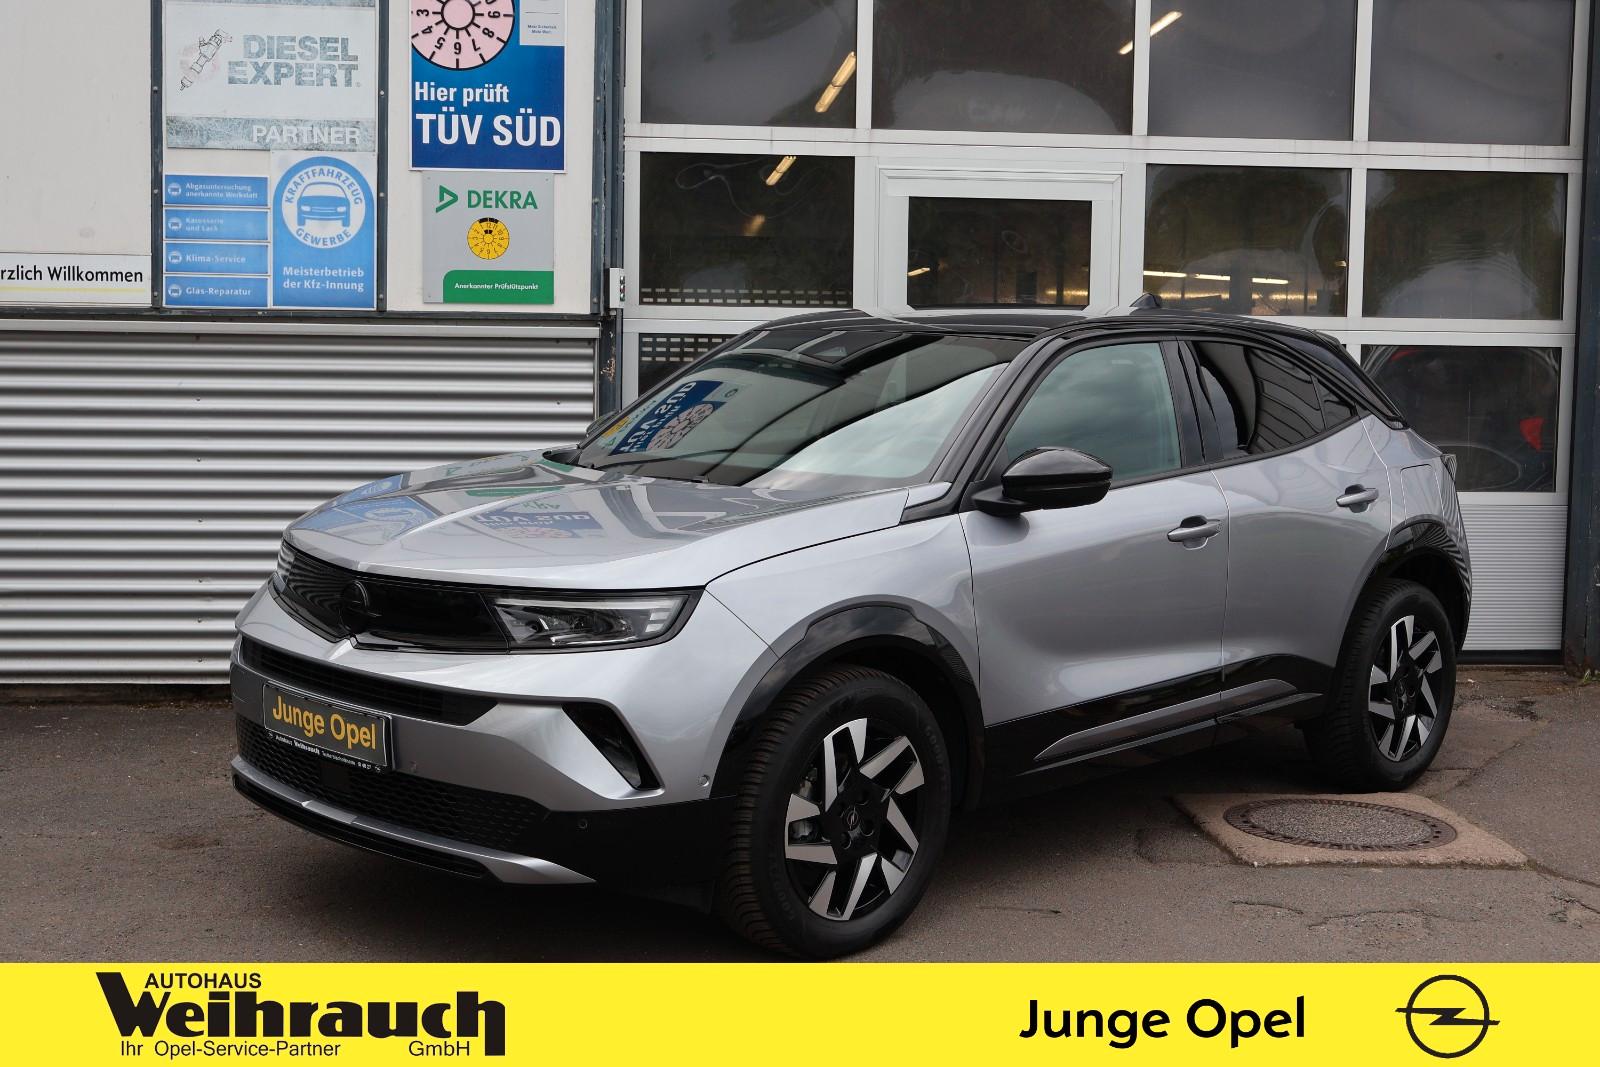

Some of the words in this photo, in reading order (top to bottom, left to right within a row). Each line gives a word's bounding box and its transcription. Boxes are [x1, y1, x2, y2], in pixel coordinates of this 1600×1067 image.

[416, 9, 430, 17] 3
[487, 10, 501, 19] 9
[421, 25, 434, 35] 4
[482, 27, 495, 39] 8
[243, 34, 359, 62] DIESEL
[434, 36, 446, 50] 5
[453, 42, 462, 55] 6
[471, 38, 481, 52] 7
[414, 81, 457, 102] Hier
[462, 83, 510, 107] prüft
[415, 106, 483, 145] TÜV
[492, 107, 561, 147] SÜD
[252, 125, 360, 145] PARTNER
[284, 167, 363, 206] KRAFTFAHRZEUG
[467, 189, 538, 210] DEKRA
[295, 227, 352, 247] GEWERBE
[185, 255, 246, 263] Klima-Service
[47, 265, 143, 282] Willkommen
[283, 266, 364, 277] Meisterbetrieb
[185, 287, 252, 297] Glas-Reparatur
[283, 279, 301, 289] der
[303, 280, 364, 292] Kfz-Innung
[454, 282, 493, 290] Anerkannter
[494, 282, 539, 293] Prüfstützpunkt
[272, 695, 325, 738] Junge
[330, 713, 376, 750] Opel
